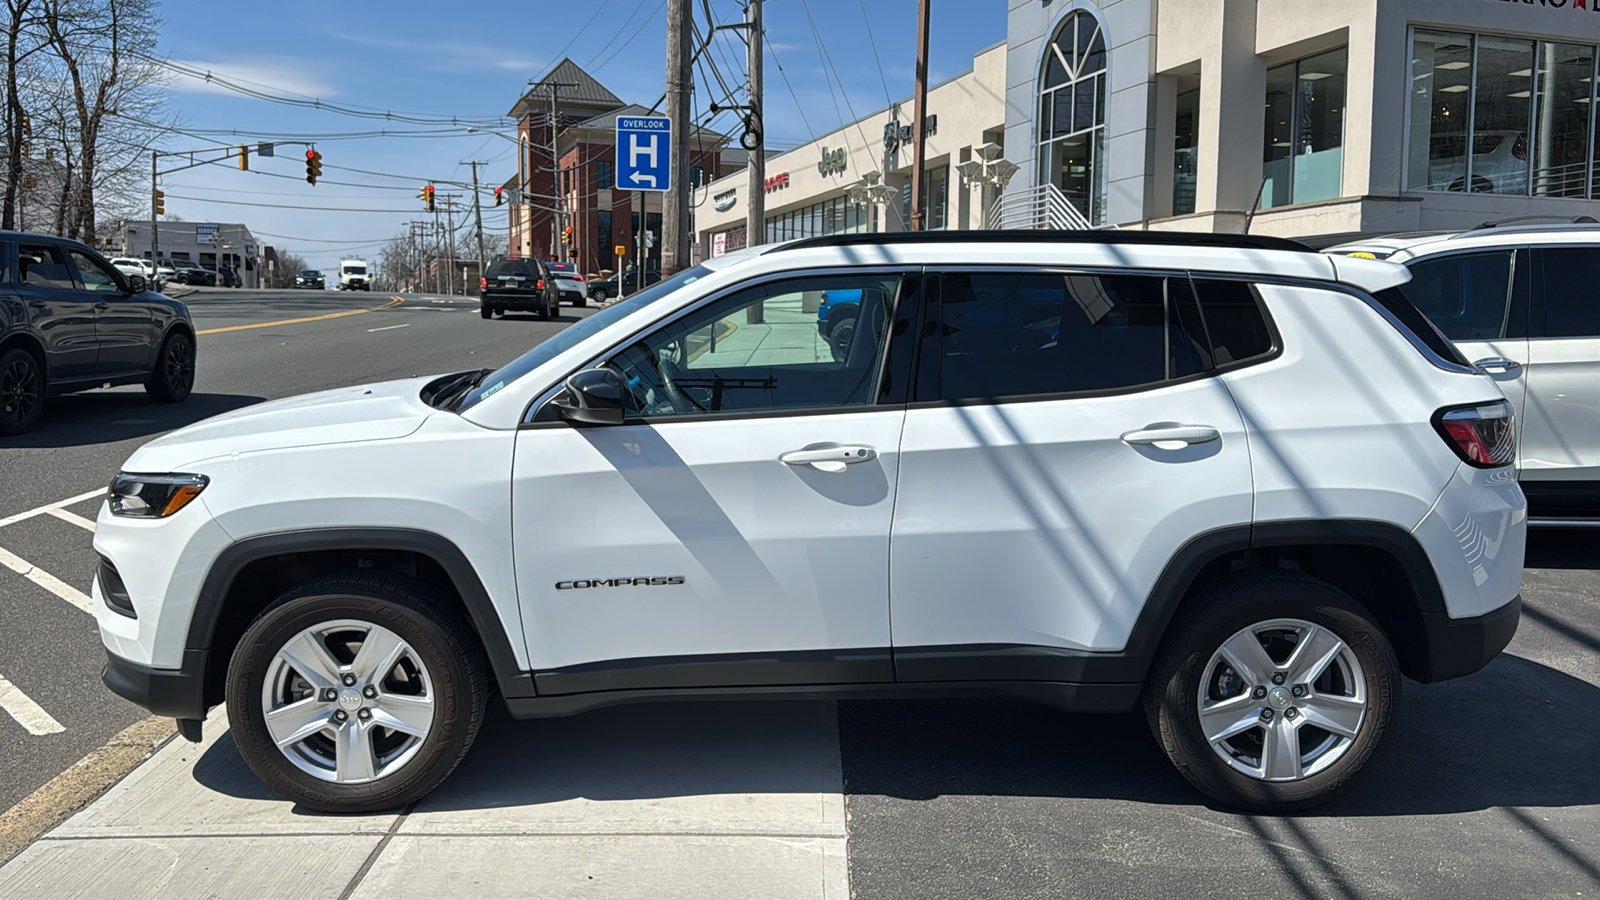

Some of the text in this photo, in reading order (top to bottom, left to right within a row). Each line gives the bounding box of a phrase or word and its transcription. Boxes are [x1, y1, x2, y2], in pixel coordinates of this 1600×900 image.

[623, 120, 664, 128] OVERLOOK
[629, 134, 658, 168] H
[818, 146, 847, 175] Jeep
[555, 576, 685, 589] COMPASS
